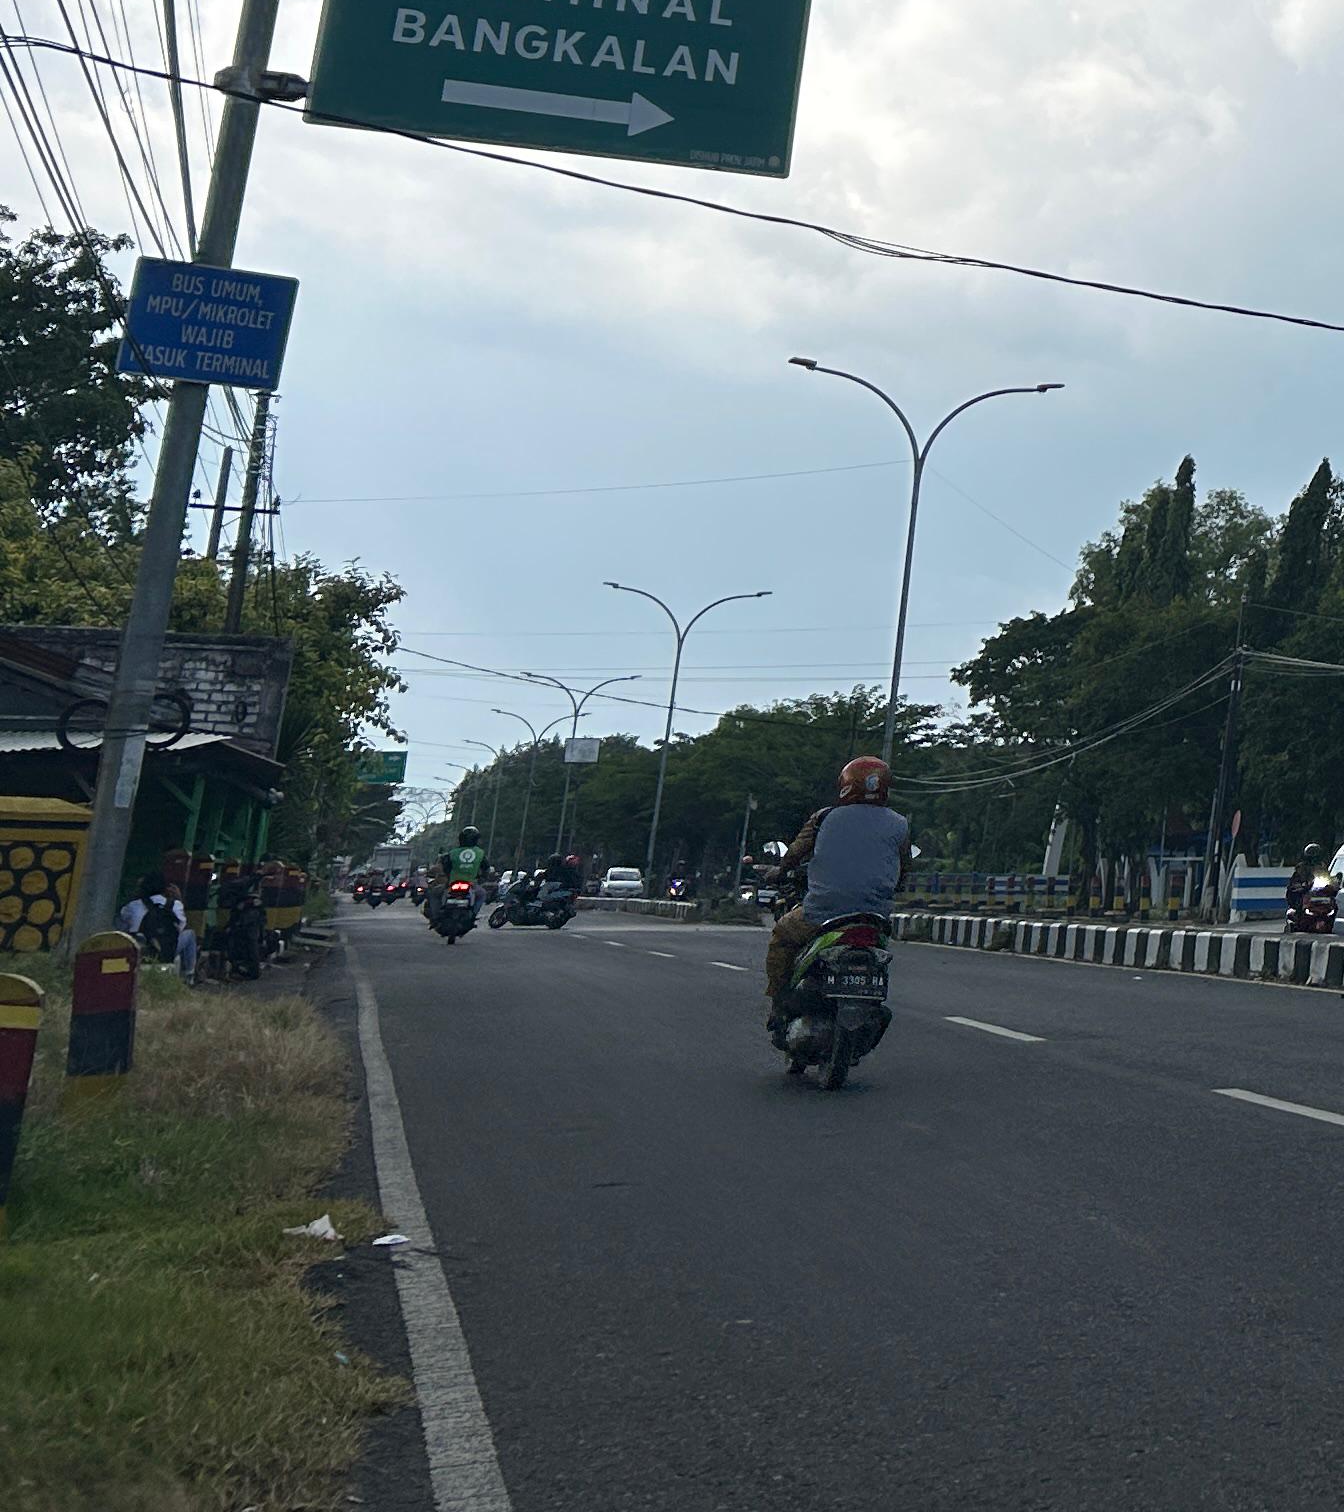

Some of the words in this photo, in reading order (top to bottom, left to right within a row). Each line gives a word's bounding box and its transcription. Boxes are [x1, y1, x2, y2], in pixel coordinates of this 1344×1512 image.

[393, 8, 740, 85] BANGKALAN
[172, 273, 206, 295] BUS
[146, 294, 275, 330] MPU/MIKROLET
[181, 324, 234, 349] WAJIB
[195, 351, 270, 379] TERMINAL
